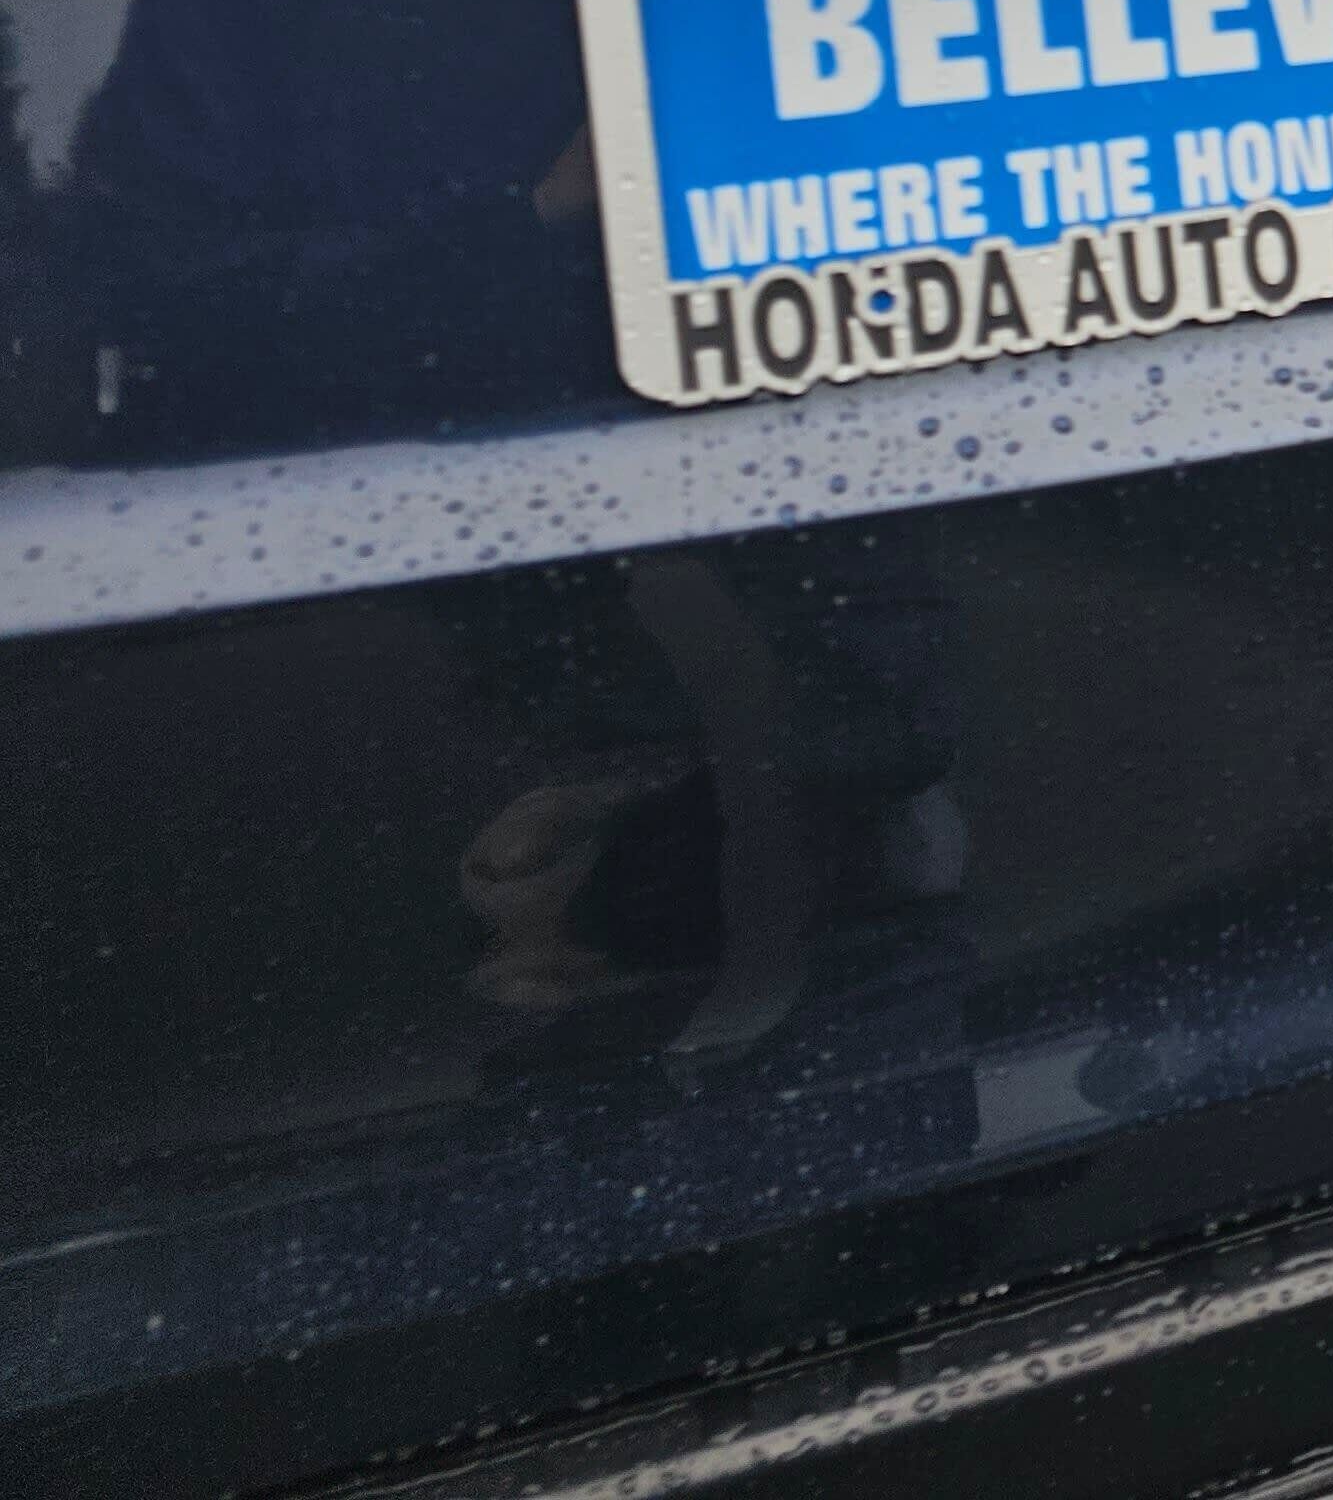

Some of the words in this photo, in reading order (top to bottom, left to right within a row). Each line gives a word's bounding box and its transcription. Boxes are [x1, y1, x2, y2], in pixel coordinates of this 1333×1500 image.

[685, 156, 987, 271] WHERE
[1006, 136, 1154, 230] THE
[672, 248, 1031, 393] HONDA
[1062, 209, 1298, 335] AUTO
